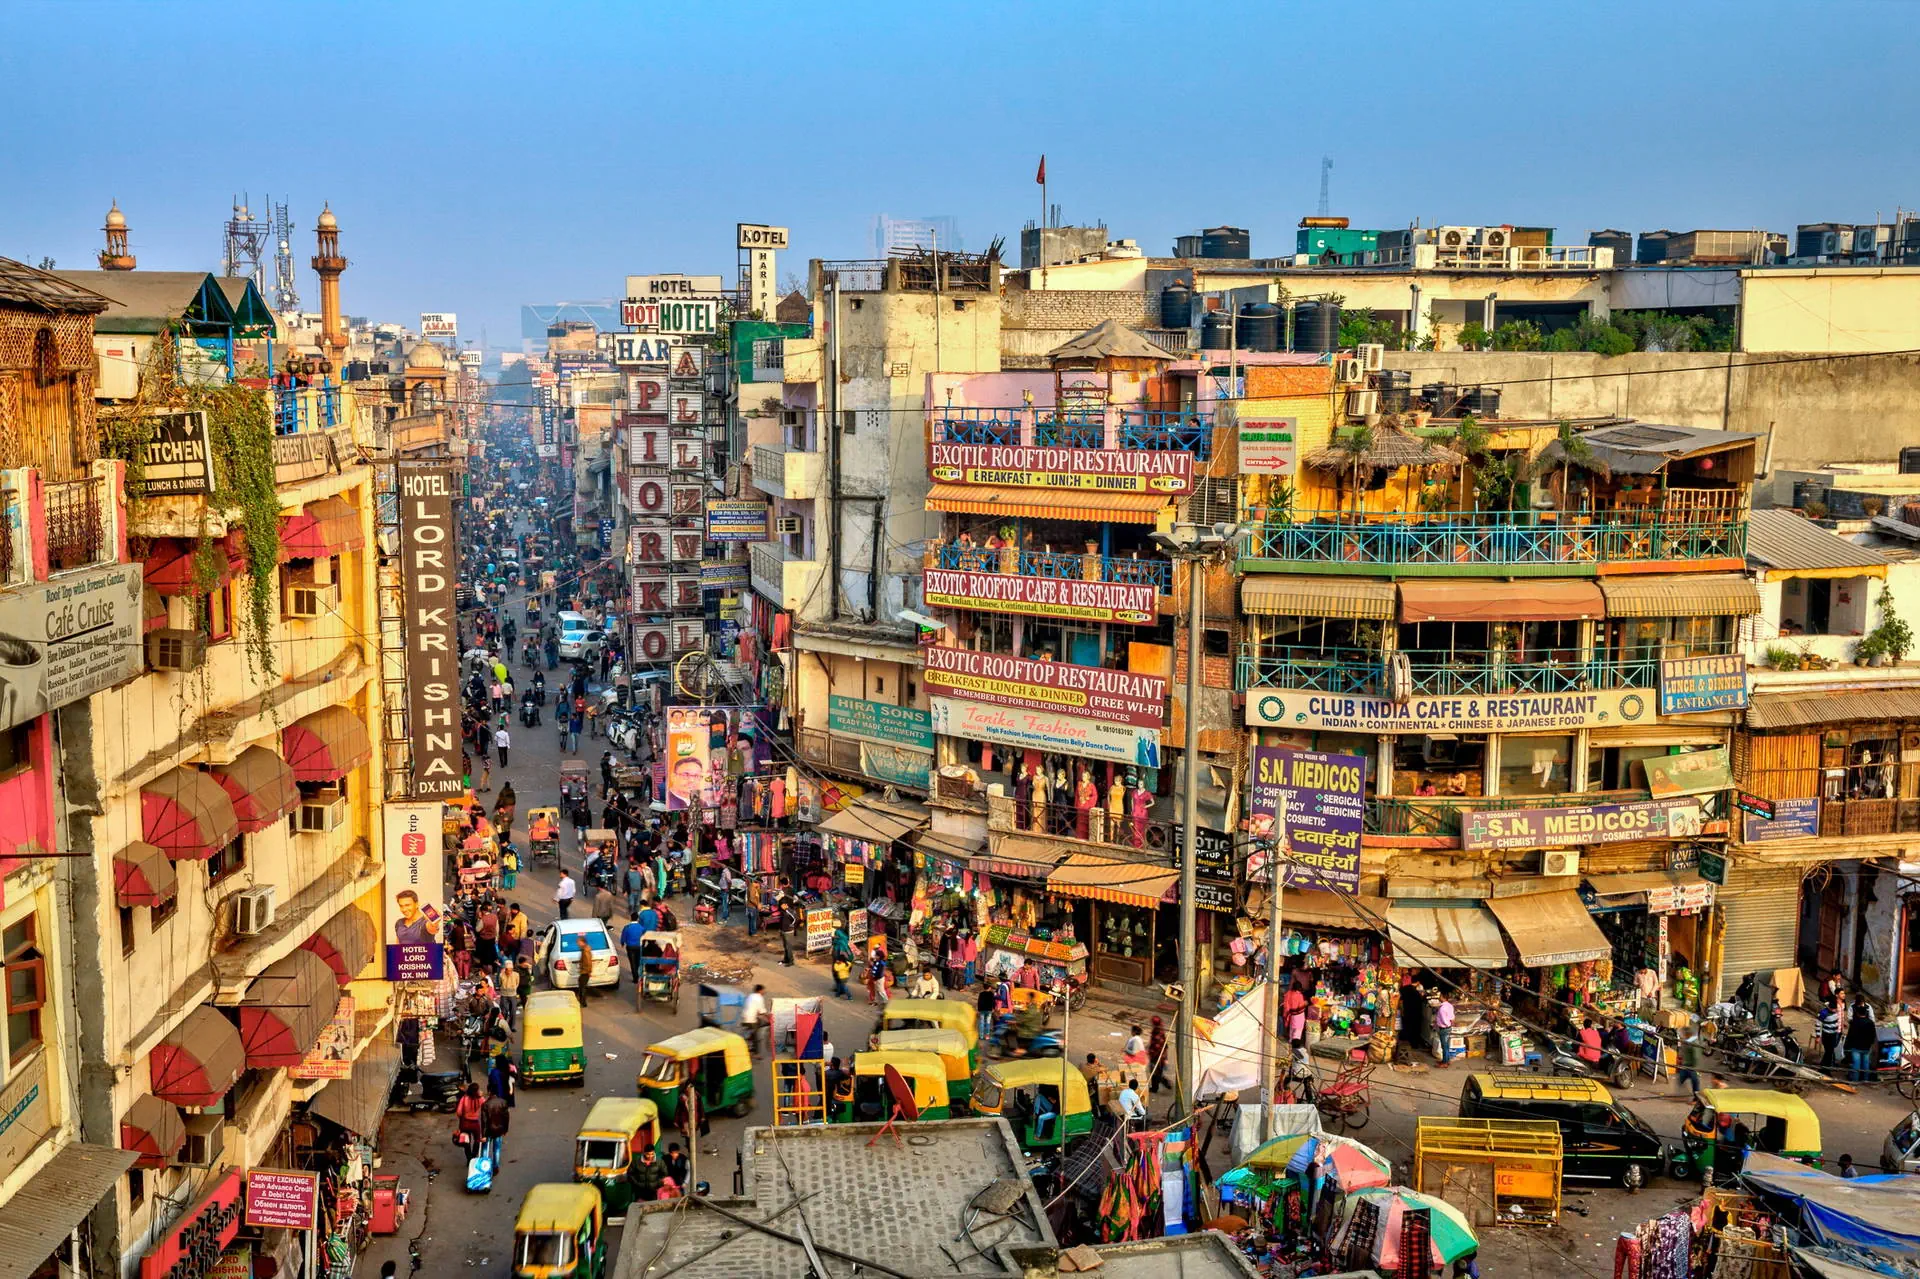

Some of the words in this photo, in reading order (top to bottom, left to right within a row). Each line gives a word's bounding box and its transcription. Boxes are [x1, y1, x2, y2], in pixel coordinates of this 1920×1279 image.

[743, 230, 786, 244] HOTEL
[759, 252, 768, 288] HARI
[650, 280, 695, 293] HOTEL
[624, 306, 659, 324] HOT
[660, 303, 715, 332] HOTEL
[425, 322, 454, 331] AMAN
[617, 338, 681, 361] HAR
[1240, 432, 1265, 442] CLUB
[1266, 432, 1293, 442] INDIA
[144, 441, 204, 464] ITCHEN
[932, 445, 987, 466] EXOTIC
[991, 448, 1068, 470] ROOFTOP
[1073, 450, 1189, 474] RESTAURANT
[148, 479, 171, 491] LUNCH
[172, 479, 178, 489] &
[179, 478, 206, 489] DINNER
[404, 475, 449, 497] HOTEL
[974, 471, 1032, 484] BREAKFAST
[1046, 474, 1081, 486] LUNCH
[1096, 476, 1137, 489] DINNER
[637, 381, 667, 659] PIORKO
[413, 501, 446, 592] LORD
[46, 588, 60, 603] Roof
[62, 585, 72, 601] Top
[73, 582, 86, 595] with
[107, 571, 126, 586] Garden
[926, 571, 967, 596] EXOTIC
[969, 575, 1023, 600] ROOFTOP
[1026, 580, 1057, 604] CAFE
[1060, 582, 1069, 604] &
[1072, 583, 1153, 611] RESTAURANT
[951, 596, 972, 607] Indian,
[1001, 602, 1039, 612] Continental,
[45, 604, 74, 640] Café
[78, 598, 114, 630] Cruise
[927, 648, 980, 673] EXOTIC
[982, 656, 1054, 684] ROOFTOP
[1058, 666, 1165, 700] RESTAURANT
[1665, 657, 1742, 678] BREAKFAST
[418, 607, 456, 776] KRISHNA
[928, 671, 988, 689] BREAKFAST
[990, 681, 1026, 695] LUNCH
[1029, 688, 1038, 697] &
[1040, 688, 1084, 703] DINNER
[1666, 678, 1695, 694] LUNCH
[1698, 678, 1706, 691] &
[1708, 676, 1743, 691] DINNER
[838, 699, 875, 713] HIRA
[880, 706, 925, 722] SONS
[953, 689, 995, 701] REMEMBER
[1008, 698, 1024, 706] FOR
[1025, 701, 1067, 712] DELICIOUS
[1068, 706, 1090, 716] FOOD
[1092, 710, 1130, 721] SERVICES
[1089, 696, 1124, 710] (FREE
[1126, 702, 1164, 718] WI-FI)
[1309, 697, 1355, 717] CLUB
[1361, 701, 1410, 719] INDIA
[1416, 701, 1462, 718] CAFE
[1468, 700, 1480, 718] &
[1487, 696, 1597, 717] RESTAURANT
[1677, 694, 1734, 709] ENTRANCE
[837, 716, 859, 727] READY
[862, 721, 881, 730] MADE
[884, 726, 925, 739] GARMENTS
[964, 707, 1016, 728] Tanika
[1024, 715, 1087, 738] Fashion
[1322, 717, 1358, 728] INDIAN
[1366, 720, 1439, 730] CONTINENTAL
[1448, 719, 1493, 729] CHINESE
[1497, 719, 1503, 728] &
[1507, 717, 1556, 728] JAPANESE
[1559, 716, 1584, 725] FOOD
[986, 726, 999, 734] High
[1000, 728, 1020, 736] Fashion
[1021, 731, 1041, 740] Sequins
[1043, 735, 1069, 744] Garments
[1070, 739, 1084, 748] Belly
[1086, 741, 1103, 750] Dance
[1104, 744, 1126, 753] Dresses
[1259, 757, 1288, 785] S.N.
[1292, 760, 1360, 794] MEDICOS
[1263, 787, 1298, 799] CHEMIST
[1323, 794, 1363, 807] SERGICAL
[1786, 799, 1813, 807] TUITION
[1287, 814, 1326, 827] COSMETIC
[1322, 805, 1361, 819] MEDICINE
[408, 814, 418, 832] trip
[1488, 818, 1537, 837] S.N.
[1544, 810, 1650, 834] MEDICOS
[1497, 837, 1537, 847] CHEMIST
[1545, 833, 1593, 845] PHARMACY
[1602, 830, 1643, 841] COSMETIC
[408, 857, 418, 884] make
[267, 1183, 293, 1191] Advance
[277, 1177, 309, 1185] EXCHANGE
[1497, 1175, 1514, 1185] ICE
[254, 1200, 277, 1208] Обмен
[268, 1190, 284, 1198] Debit
